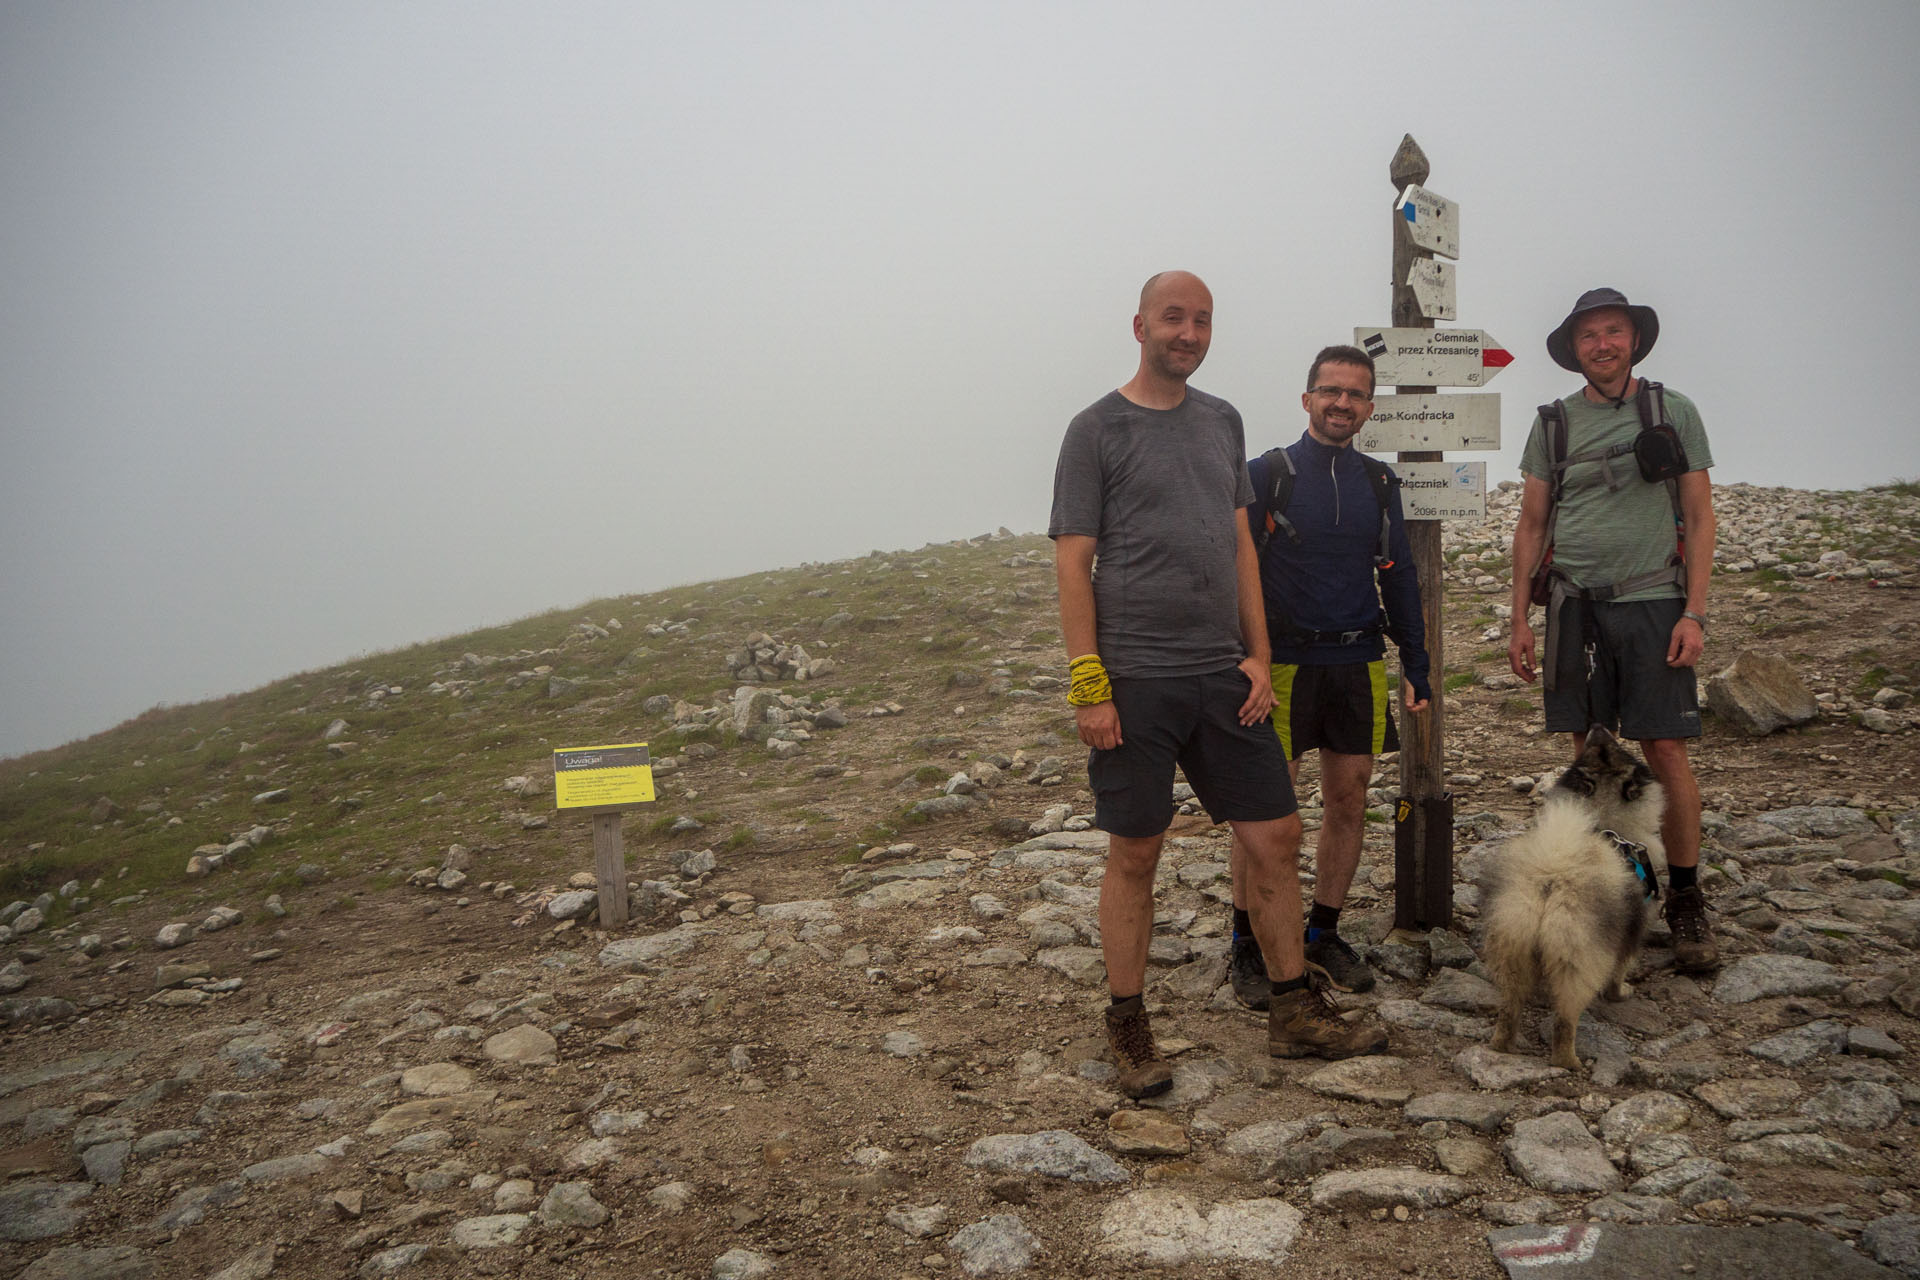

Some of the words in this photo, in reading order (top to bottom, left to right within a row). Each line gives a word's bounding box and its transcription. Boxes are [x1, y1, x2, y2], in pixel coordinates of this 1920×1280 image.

[1434, 332, 1479, 343] Ciemniak
[1398, 346, 1424, 357] przez
[1427, 345, 1480, 358] Krzesanicę
[1396, 410, 1455, 421] Kondracka
[1364, 439, 1379, 449] 40'
[1399, 478, 1449, 491] ołączniak
[1414, 508, 1437, 516] 2096
[1451, 508, 1480, 518] n.p.m.
